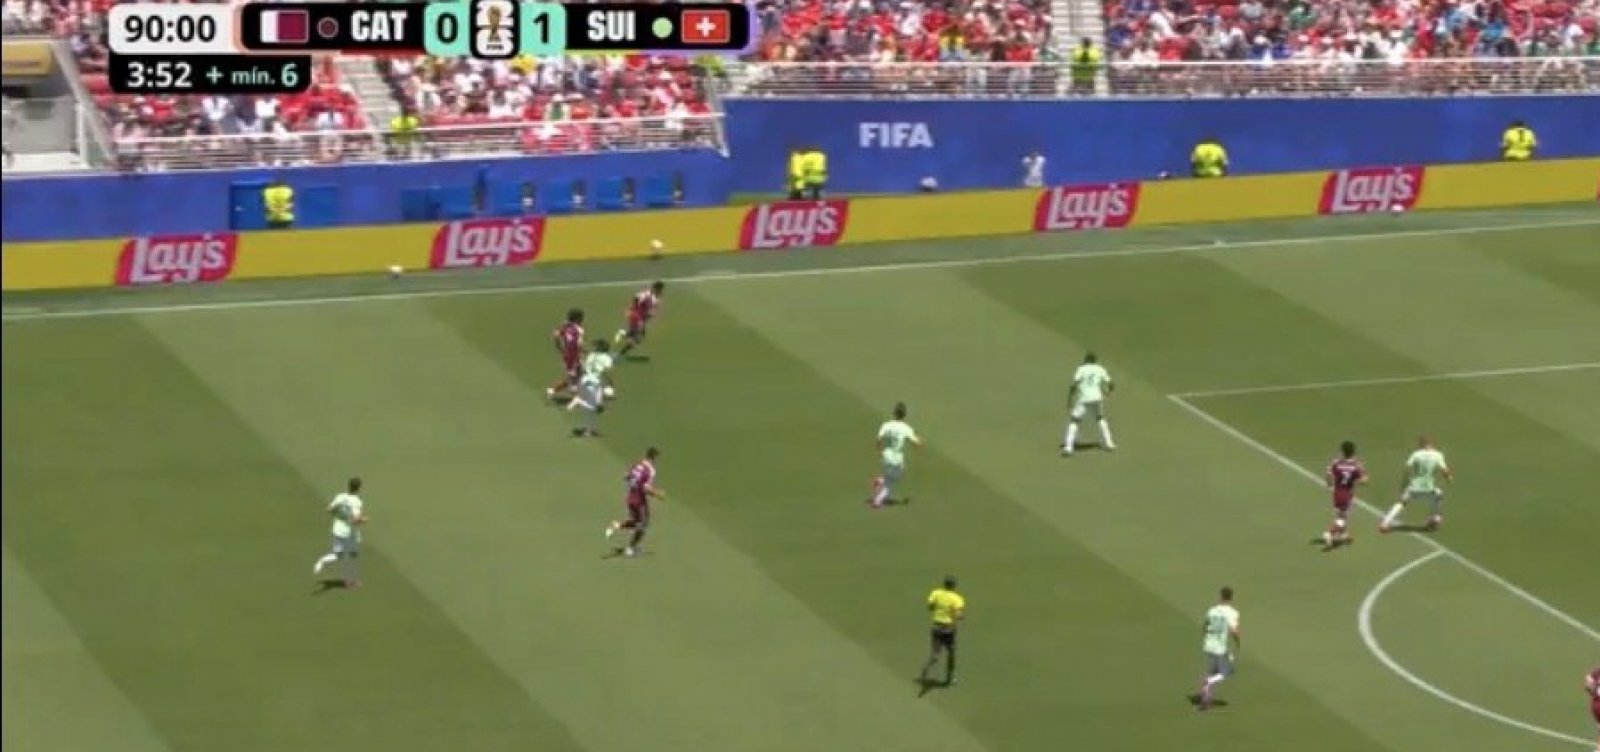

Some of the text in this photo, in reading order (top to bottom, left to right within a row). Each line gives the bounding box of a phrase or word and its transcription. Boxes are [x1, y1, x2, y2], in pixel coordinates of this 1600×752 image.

[859, 122, 933, 148] FIFA
[1047, 182, 1129, 229] Lay's
[1333, 167, 1415, 213] Lay's
[445, 218, 534, 266] Lay's
[752, 201, 838, 248] Lay's
[131, 233, 227, 282] Lay's
